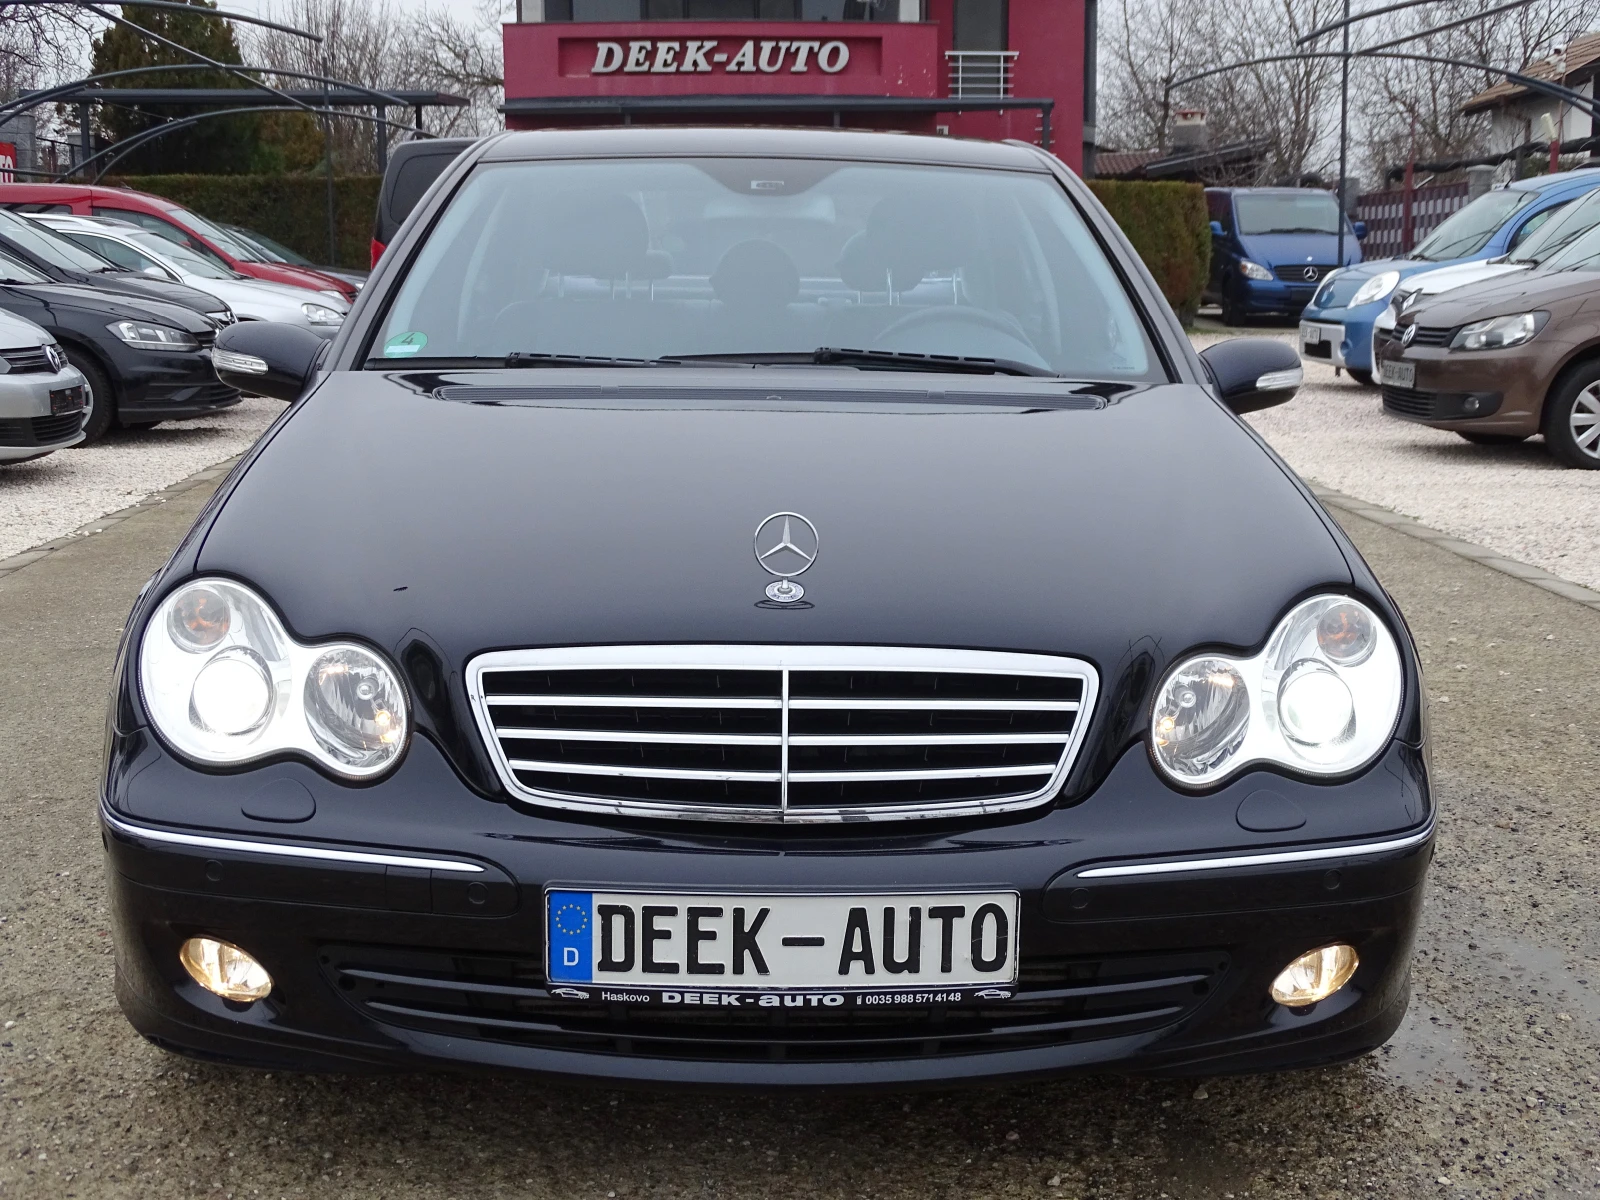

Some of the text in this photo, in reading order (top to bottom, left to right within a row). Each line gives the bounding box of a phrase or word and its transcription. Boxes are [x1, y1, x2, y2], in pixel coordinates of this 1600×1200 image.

[591, 40, 850, 73] DEEK-AUTO
[563, 947, 579, 966] D
[601, 991, 650, 1003] Haskovo
[865, 995, 892, 1004] 0035
[894, 994, 914, 1004] 988
